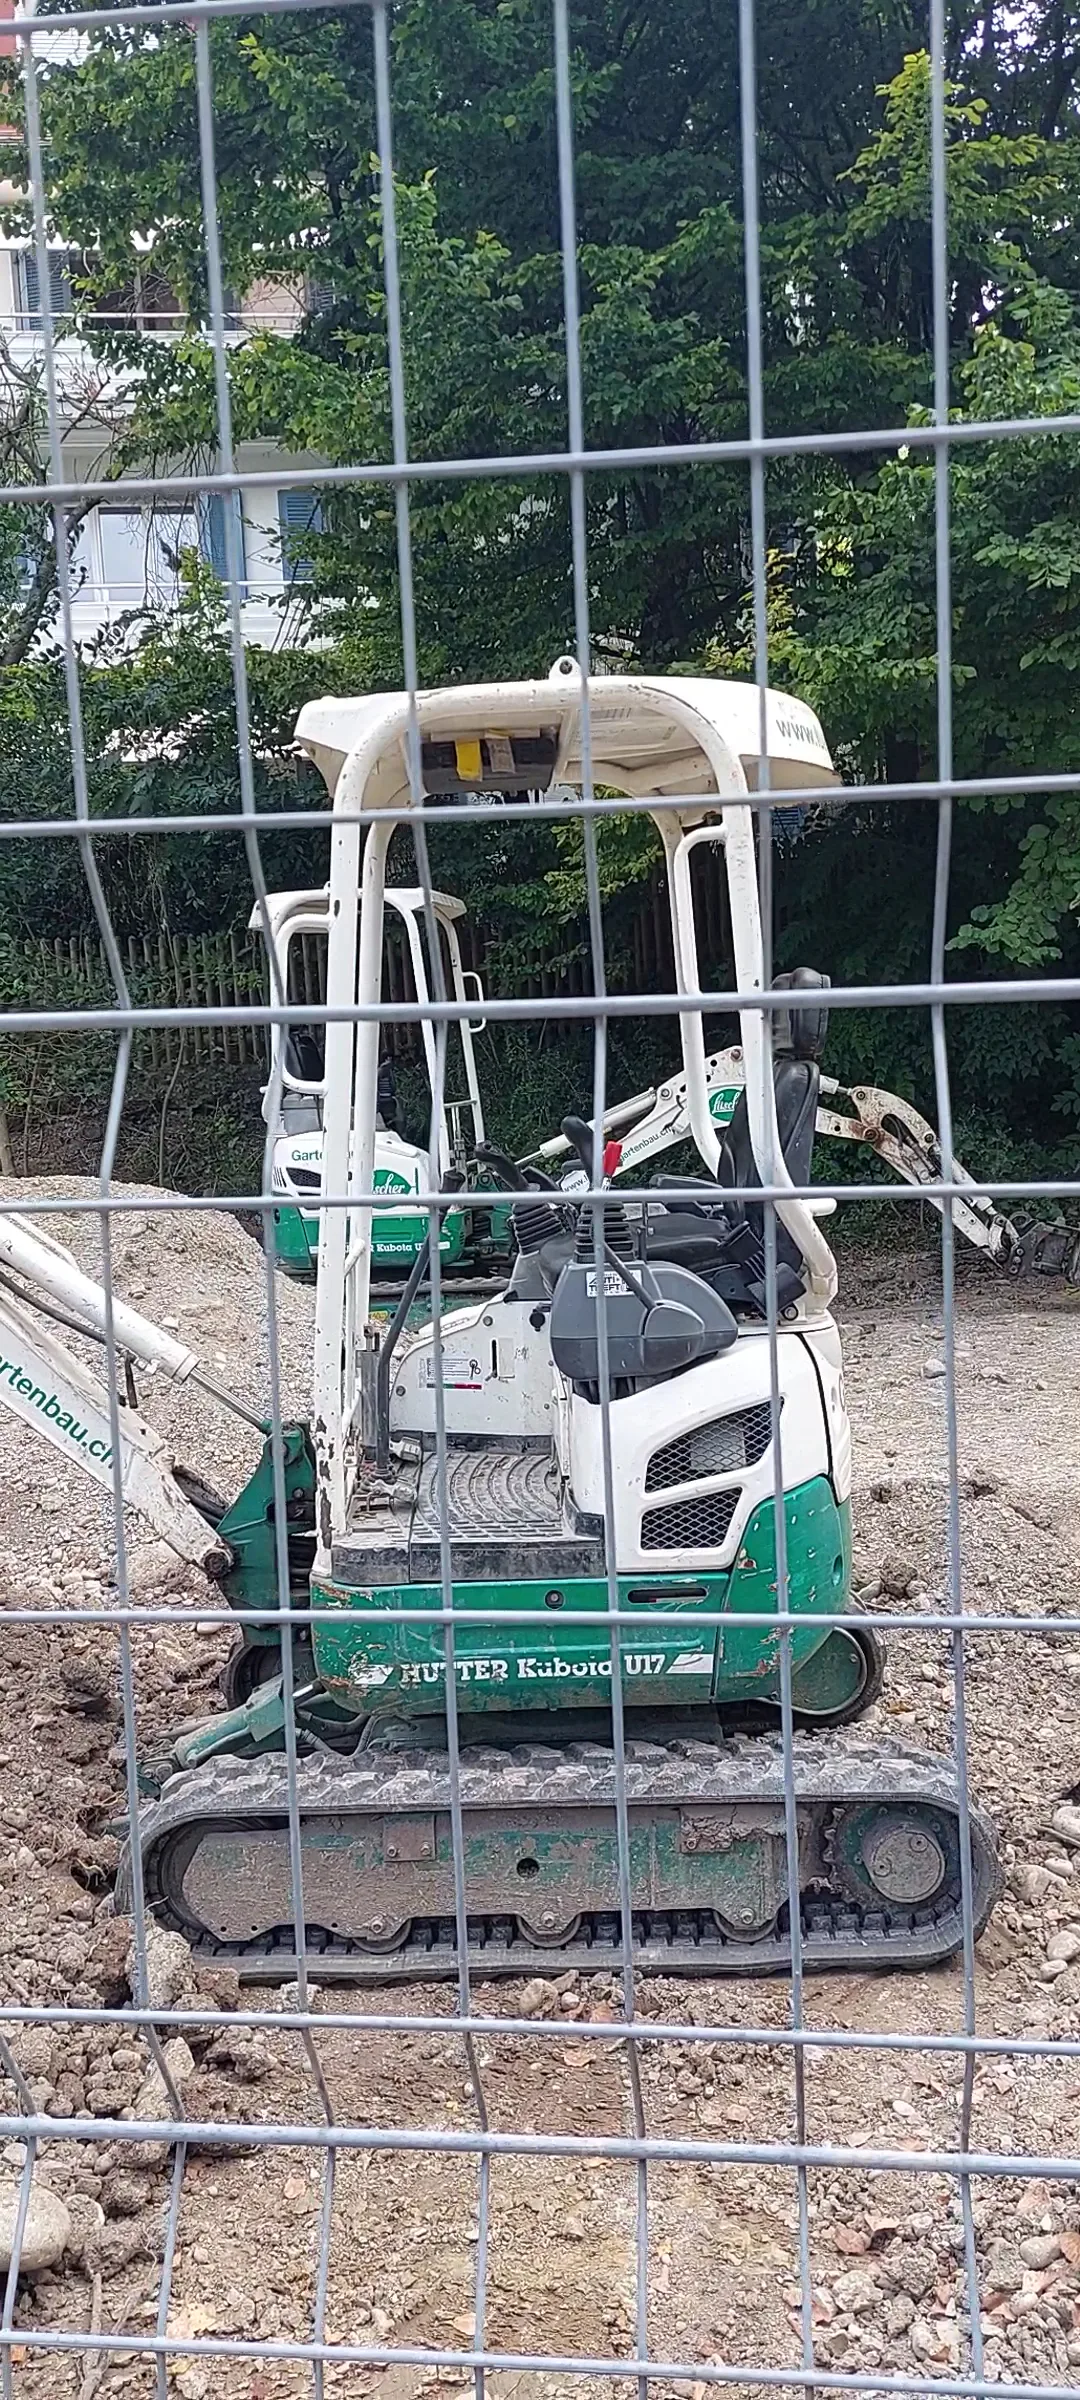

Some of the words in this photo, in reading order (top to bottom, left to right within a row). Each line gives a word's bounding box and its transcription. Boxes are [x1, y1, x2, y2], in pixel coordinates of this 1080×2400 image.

[371, 1172, 406, 1195] scher
[376, 1242, 413, 1253] Kubota
[623, 1653, 667, 1676] U17
